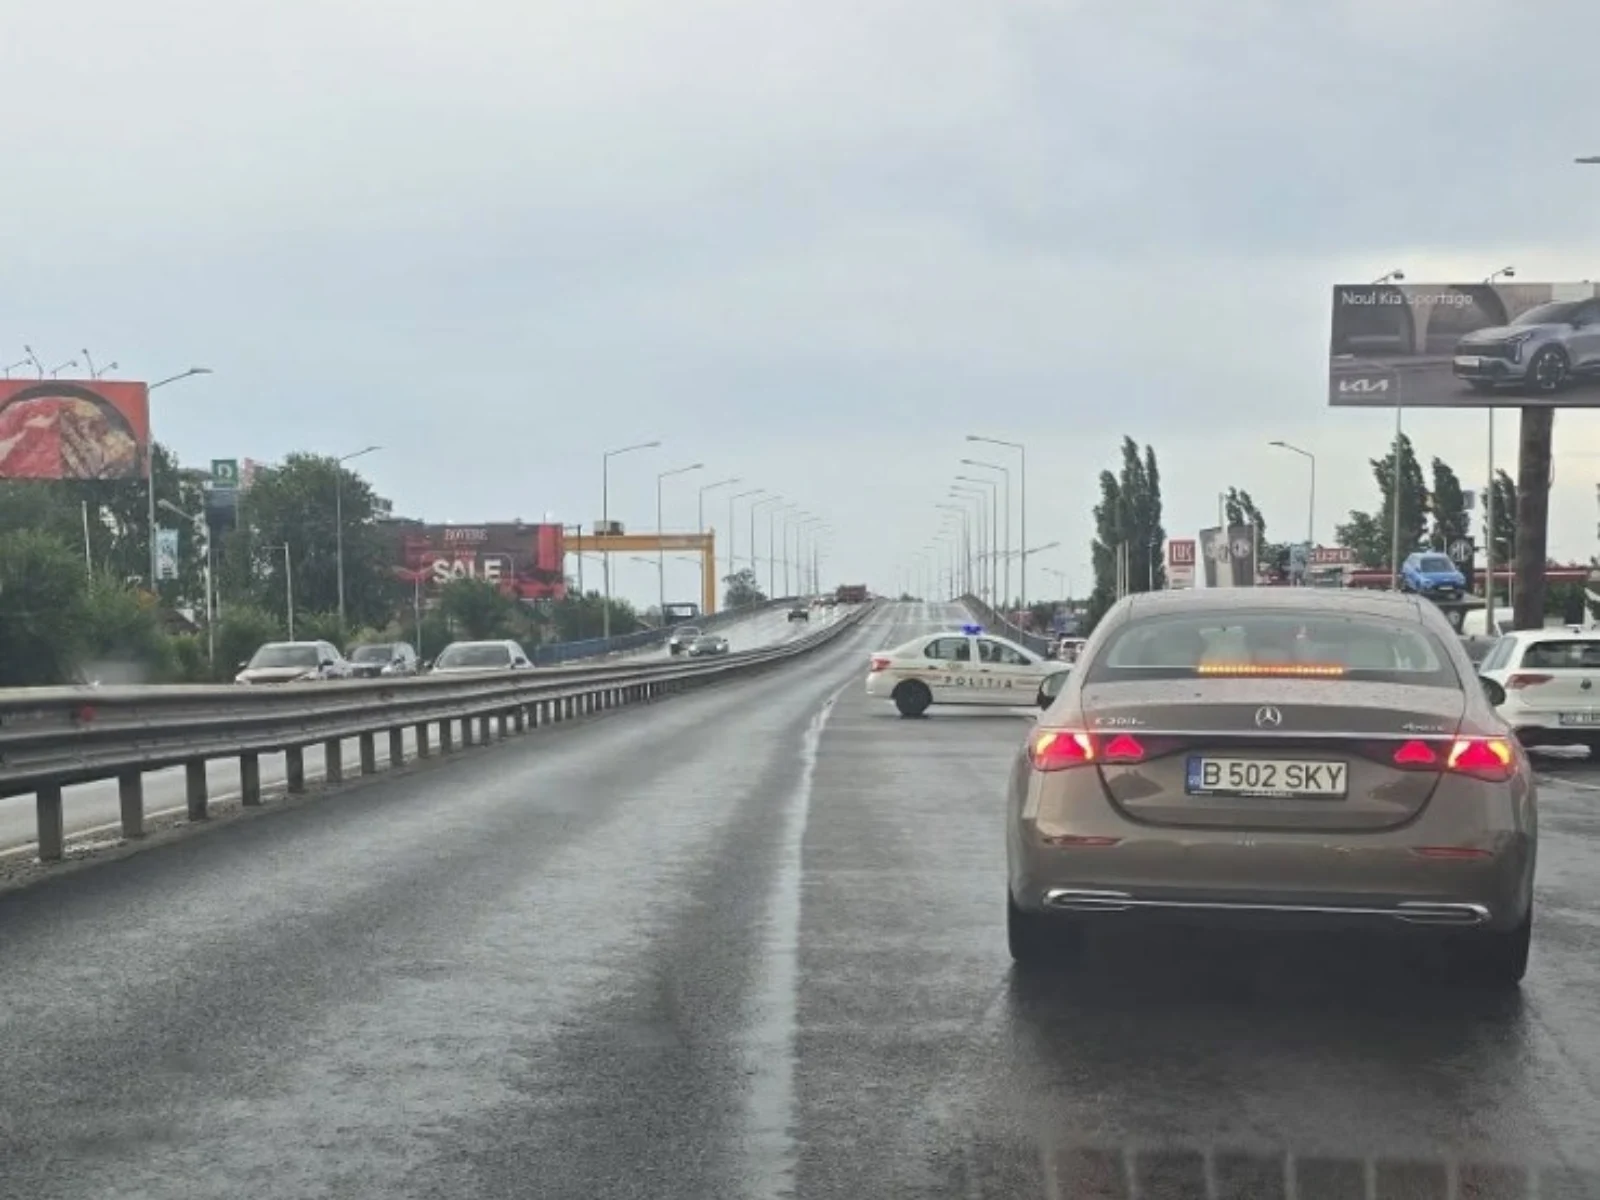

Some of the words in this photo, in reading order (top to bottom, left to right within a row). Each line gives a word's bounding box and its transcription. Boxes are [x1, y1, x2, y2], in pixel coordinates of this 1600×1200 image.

[1341, 291, 1376, 305] Noul
[1379, 291, 1402, 305] Kia
[1339, 378, 1389, 392] KIA
[432, 558, 502, 584] SALE
[1203, 762, 1221, 786] B
[1229, 763, 1276, 788] 502
[1285, 765, 1343, 790] SKY
